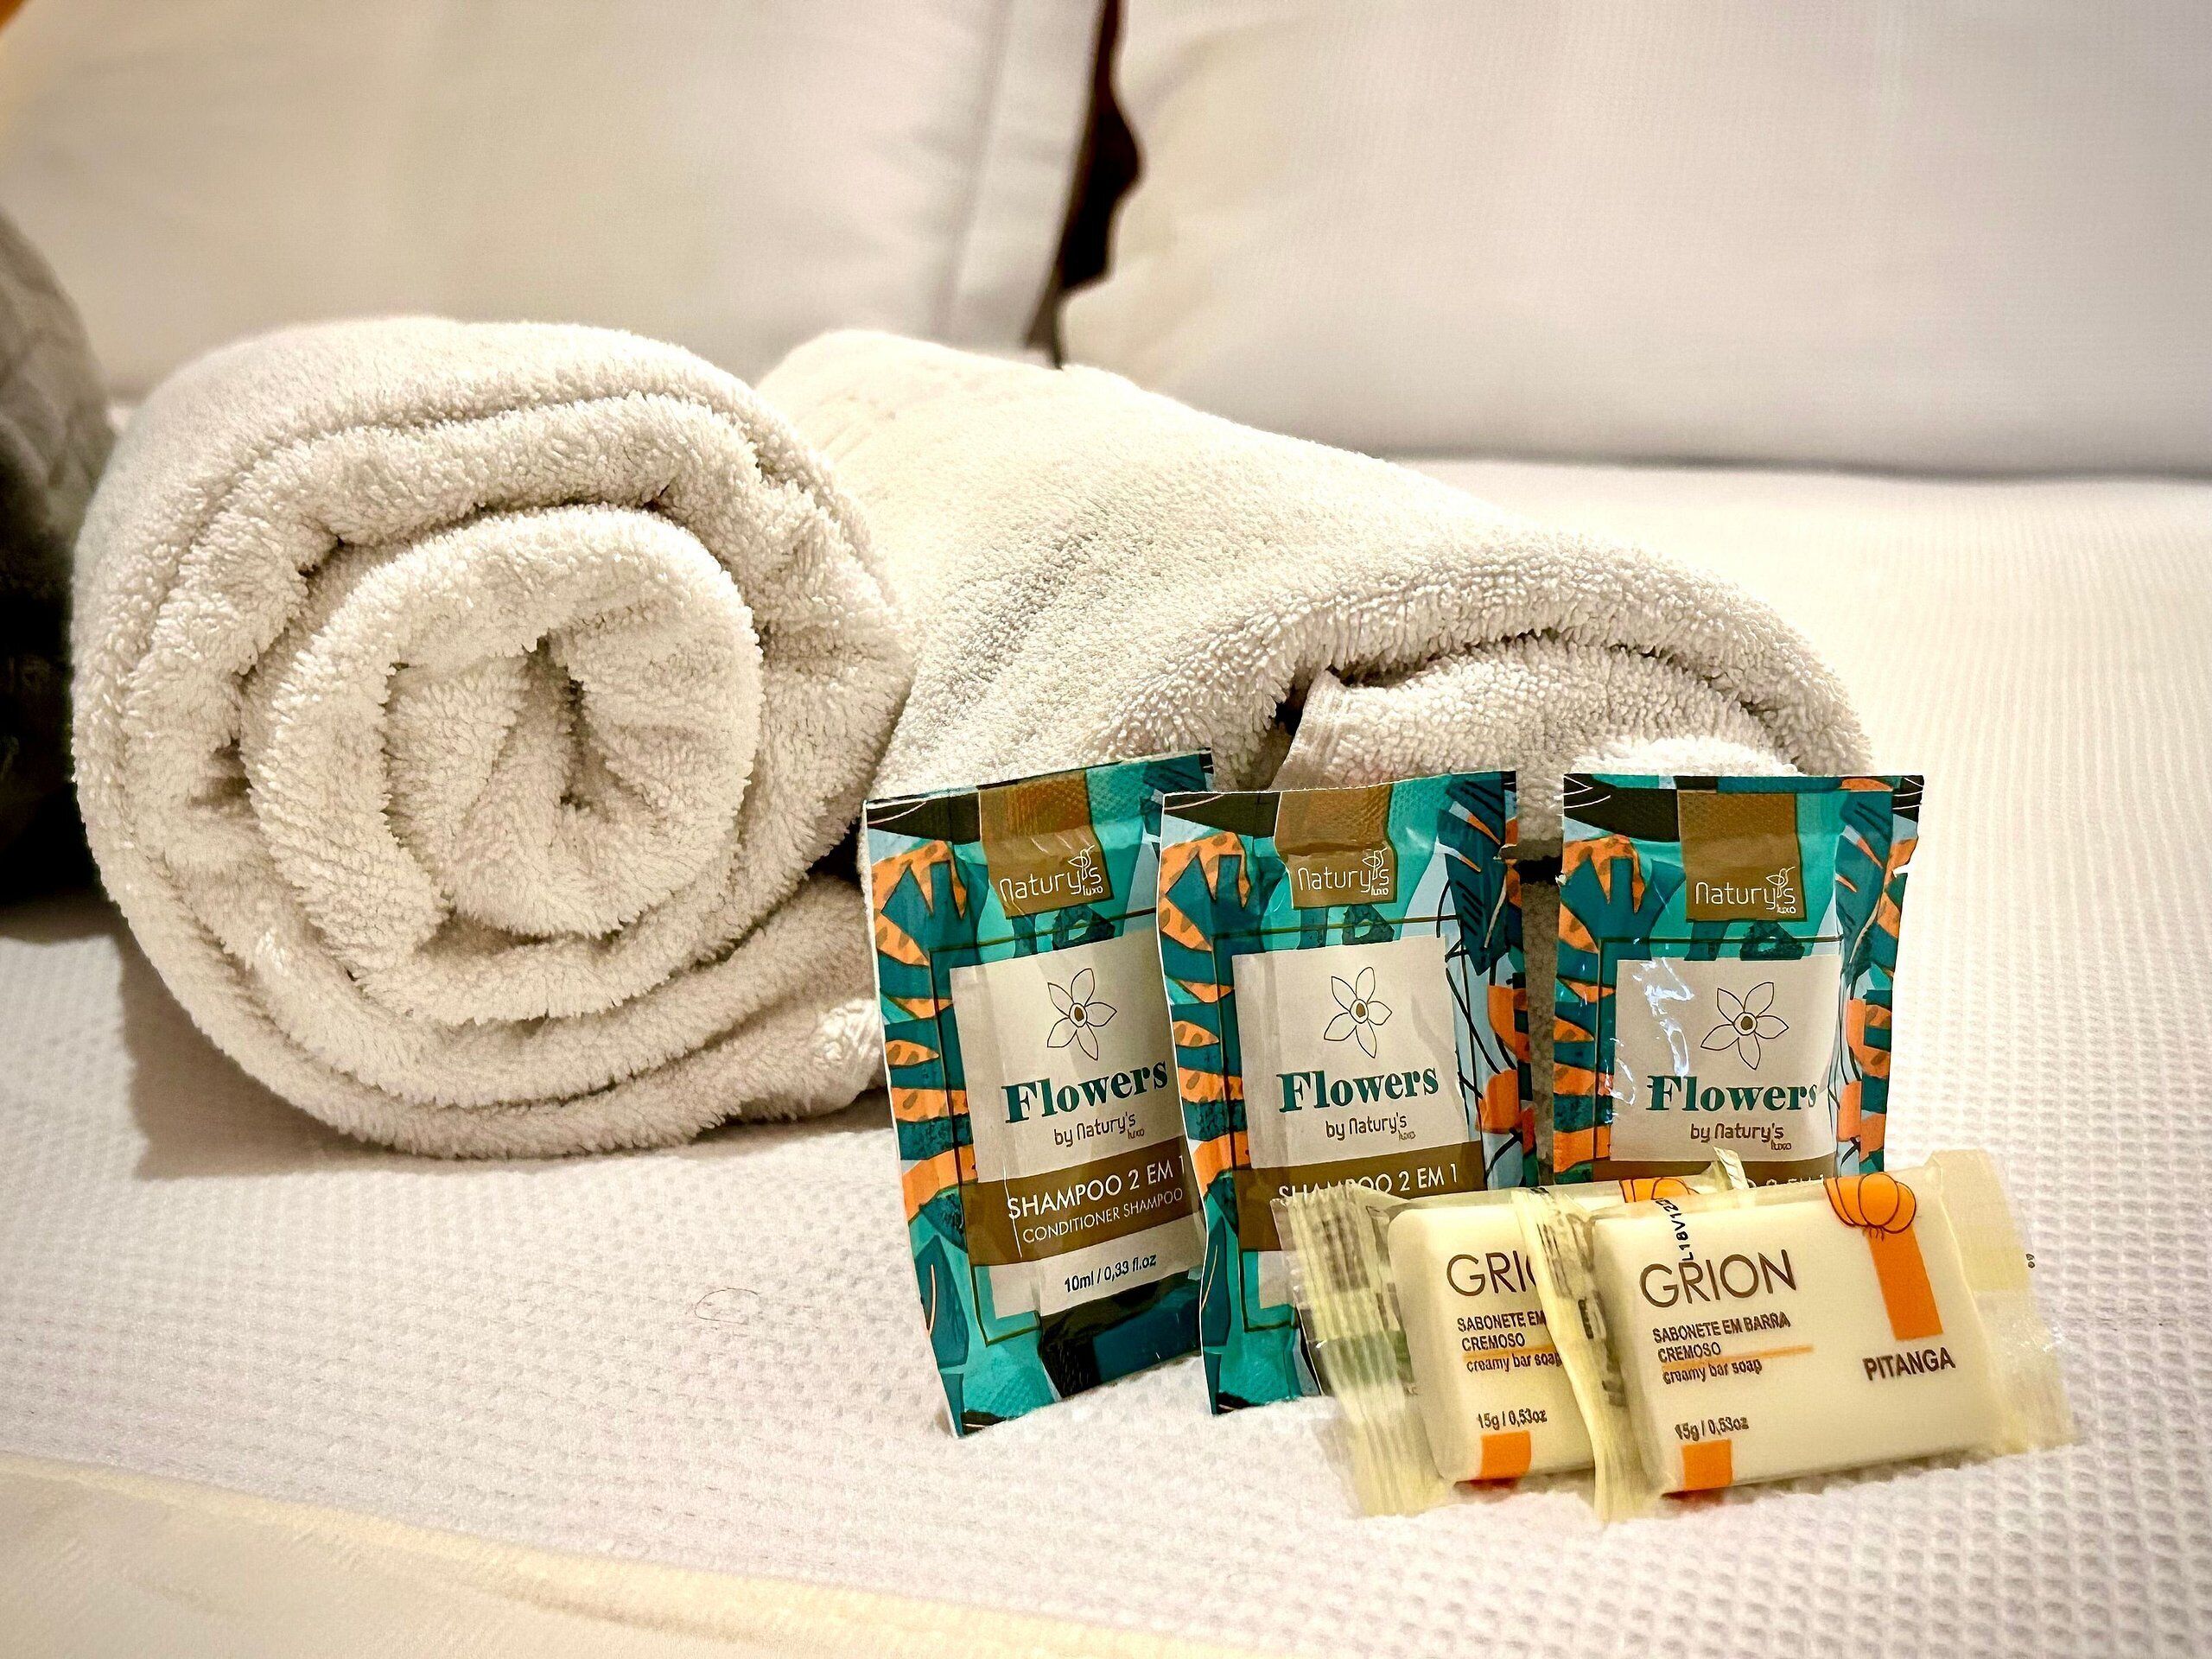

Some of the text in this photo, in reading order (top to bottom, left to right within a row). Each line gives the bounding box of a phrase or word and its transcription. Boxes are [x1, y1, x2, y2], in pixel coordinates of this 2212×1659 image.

[1001, 1060, 1167, 1123] Flowers
[1276, 1066, 1440, 1113] Flowers
[1646, 1074, 1818, 1113] Flowers
[1053, 1128, 1074, 1148] by
[1325, 1120, 1345, 1141] by
[1690, 1123, 1711, 1143] by
[1007, 1154, 1186, 1219] SHAMPOO 2 EM 1
[1397, 1170, 1411, 1192] 2
[1417, 1166, 1446, 1189] EM
[1450, 1162, 1459, 1184] 1
[1021, 1186, 1184, 1244] CONDITIONER SHAMPOO
[1064, 1270, 1095, 1294] 10ml
[1103, 1262, 1130, 1283] 0,33
[1131, 1254, 1158, 1272] fl.oz
[1446, 1249, 1537, 1297] GRI
[1640, 1248, 1797, 1308] GRION
[1457, 1310, 1548, 1332] SABONETE EM
[1651, 1311, 1791, 1344] SABONETE EM BARRA
[1461, 1332, 1526, 1351] CREMOSO
[1657, 1341, 1722, 1363] CREMOSO
[1466, 1357, 1510, 1373] creamy
[1511, 1352, 1532, 1368] bar
[1662, 1357, 1764, 1385] creamy bar soap
[1862, 1345, 1956, 1382] PITANGA
[1476, 1413, 1501, 1431] 15g
[1508, 1408, 1548, 1427] 0,53oz
[1674, 1421, 1700, 1442] 15g
